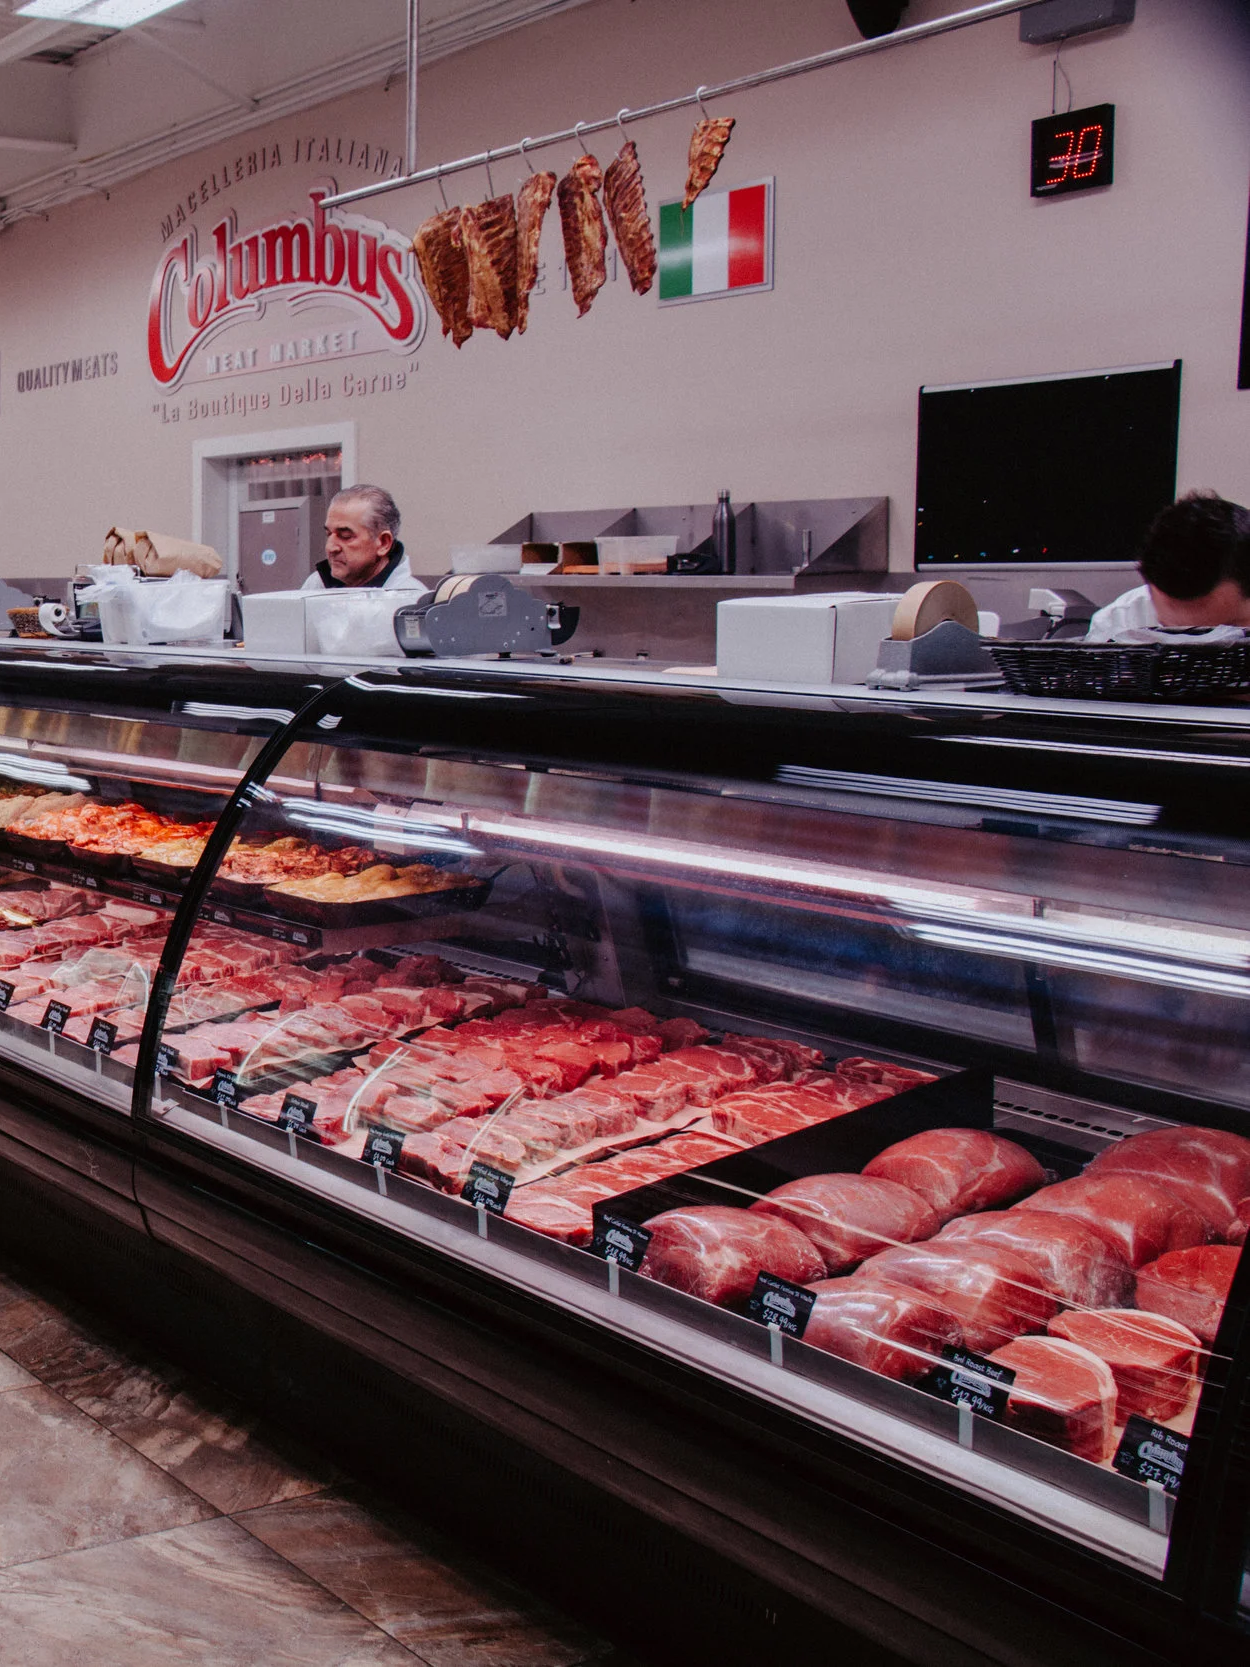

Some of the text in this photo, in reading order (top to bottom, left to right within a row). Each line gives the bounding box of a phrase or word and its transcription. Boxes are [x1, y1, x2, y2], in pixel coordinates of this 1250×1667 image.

[1046, 125, 1103, 185] 30
[160, 138, 403, 242] MACELLERIA ITALIANA
[148, 192, 414, 383] Columbus
[206, 330, 359, 375] MEAT MARKET
[188, 391, 270, 417] Boutique
[278, 375, 331, 406] Della
[966, 1358, 986, 1371] Roast
[986, 1366, 1003, 1379] Beef
[950, 1386, 995, 1414] $1299/KG
[1150, 1428, 1189, 1451] Rib Roast
